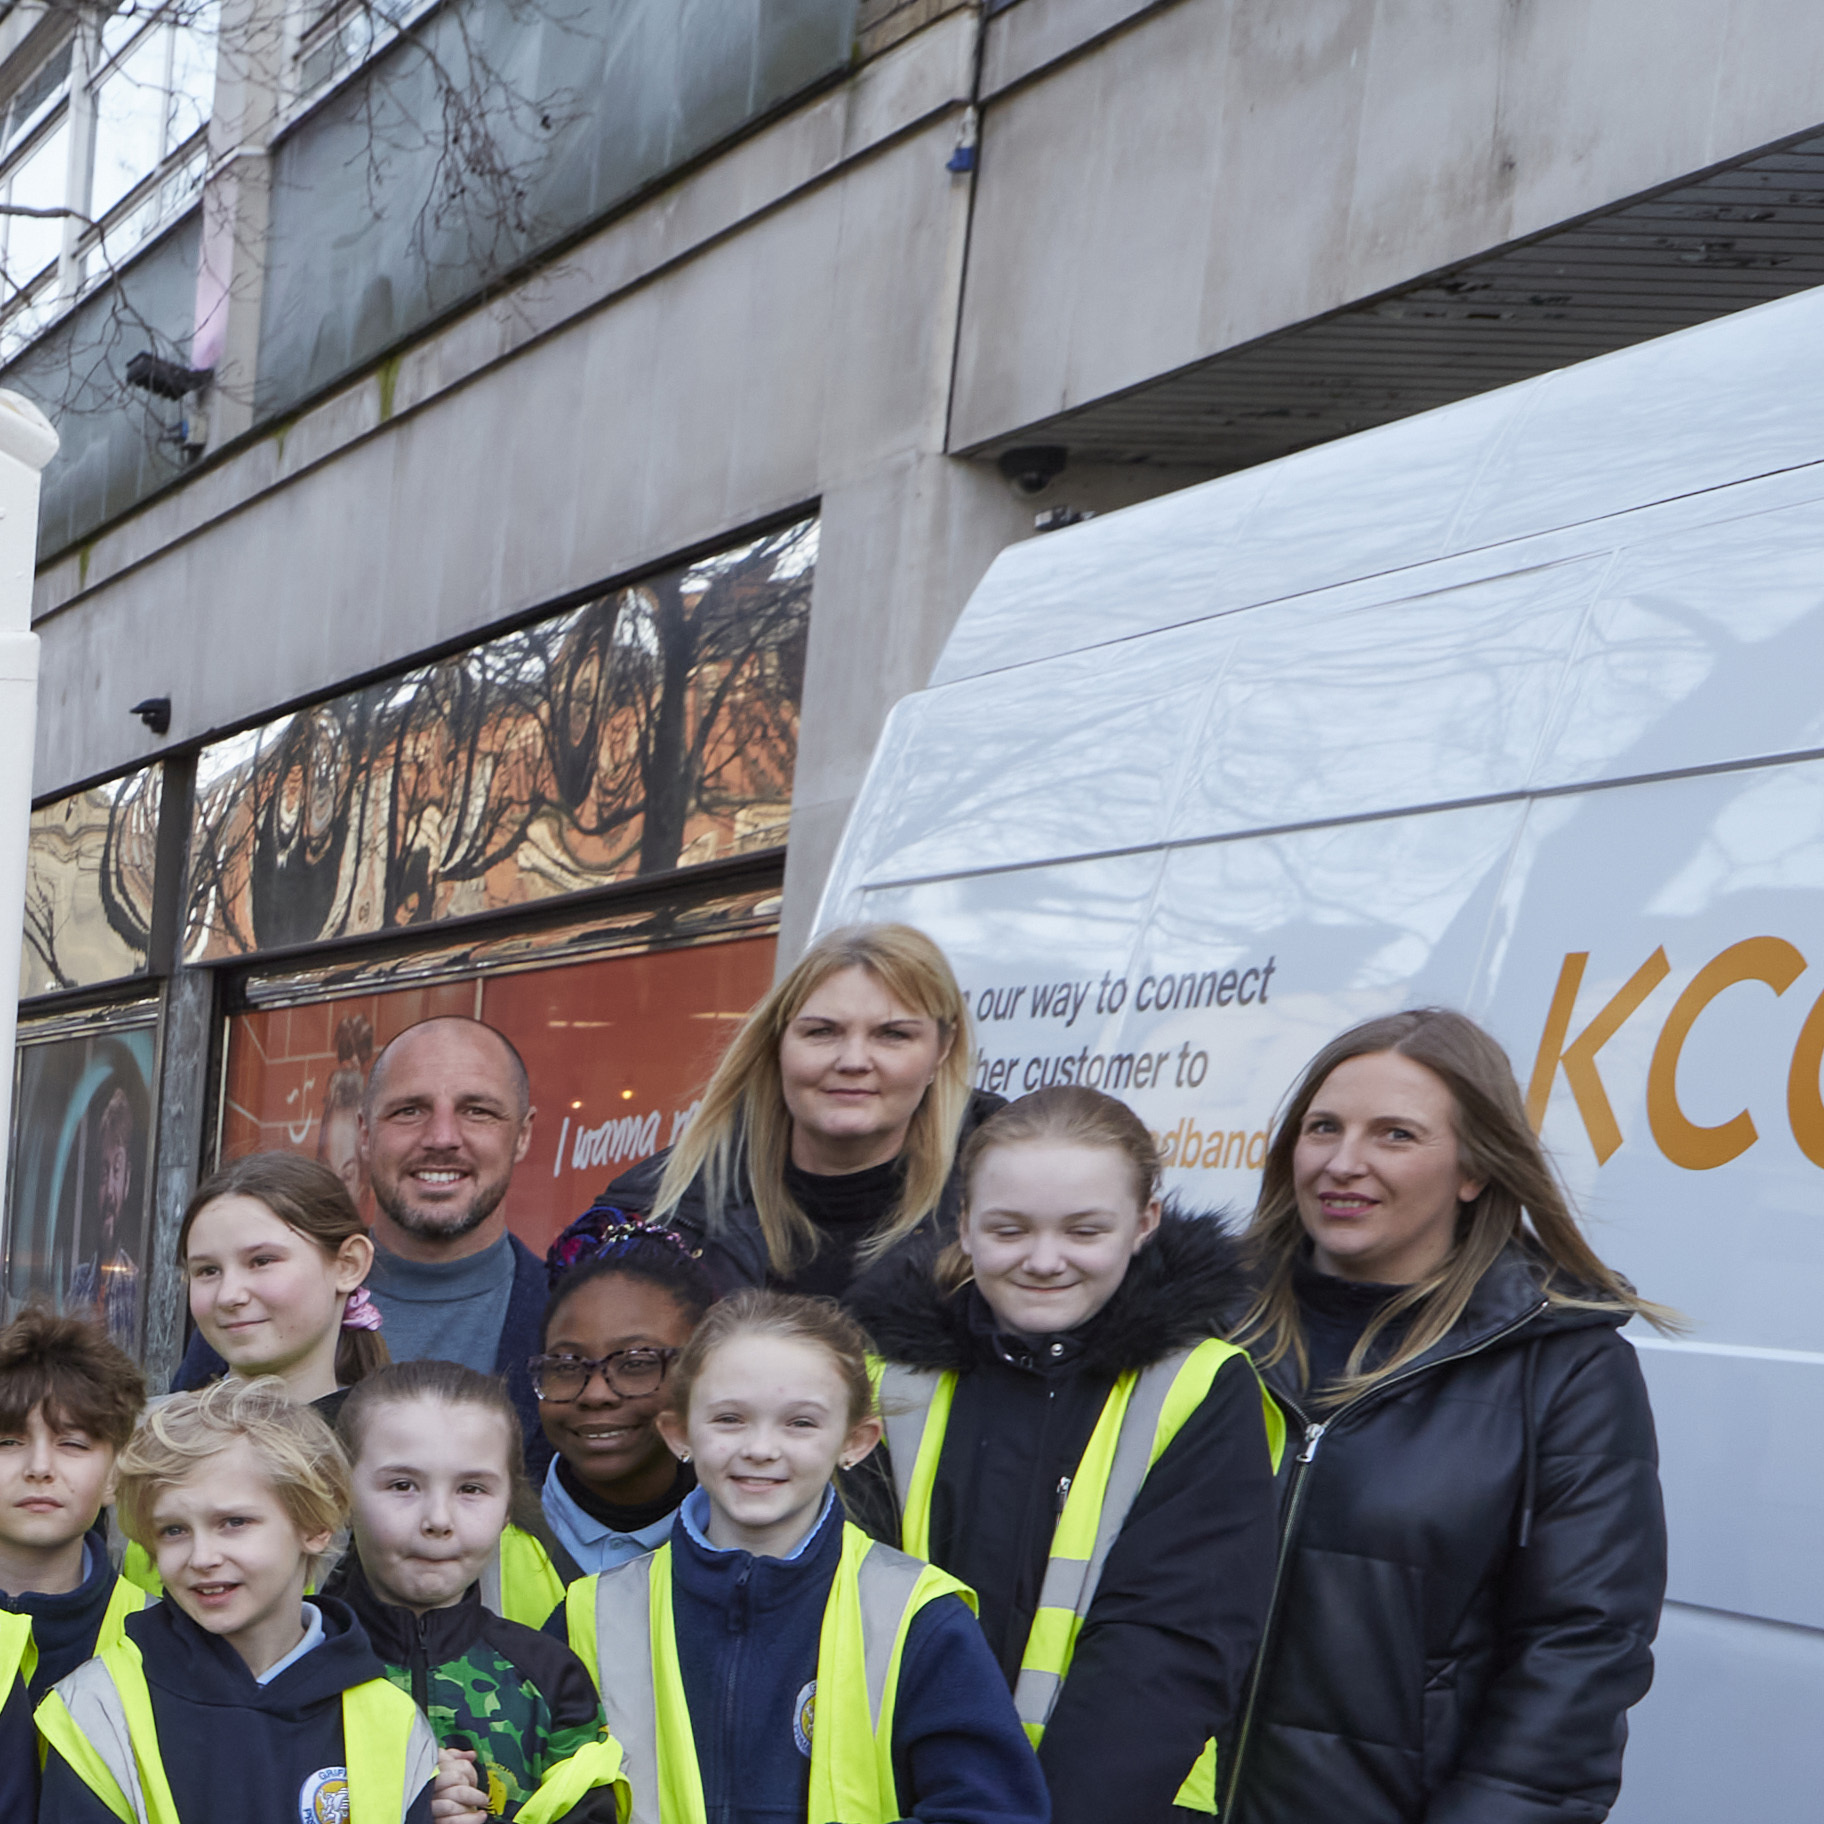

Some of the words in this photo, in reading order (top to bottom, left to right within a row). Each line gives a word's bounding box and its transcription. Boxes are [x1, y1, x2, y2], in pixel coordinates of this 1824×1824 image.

[976, 984, 1027, 1022] our
[1029, 981, 1093, 1029] way
[1096, 969, 1129, 1015] to
[1136, 954, 1277, 1013] connect
[1023, 1045, 1171, 1092] customer
[1174, 1040, 1209, 1089] to
[1524, 934, 1824, 1172] KC
[553, 1116, 571, 1178] I
[571, 1109, 662, 1171] wanna
